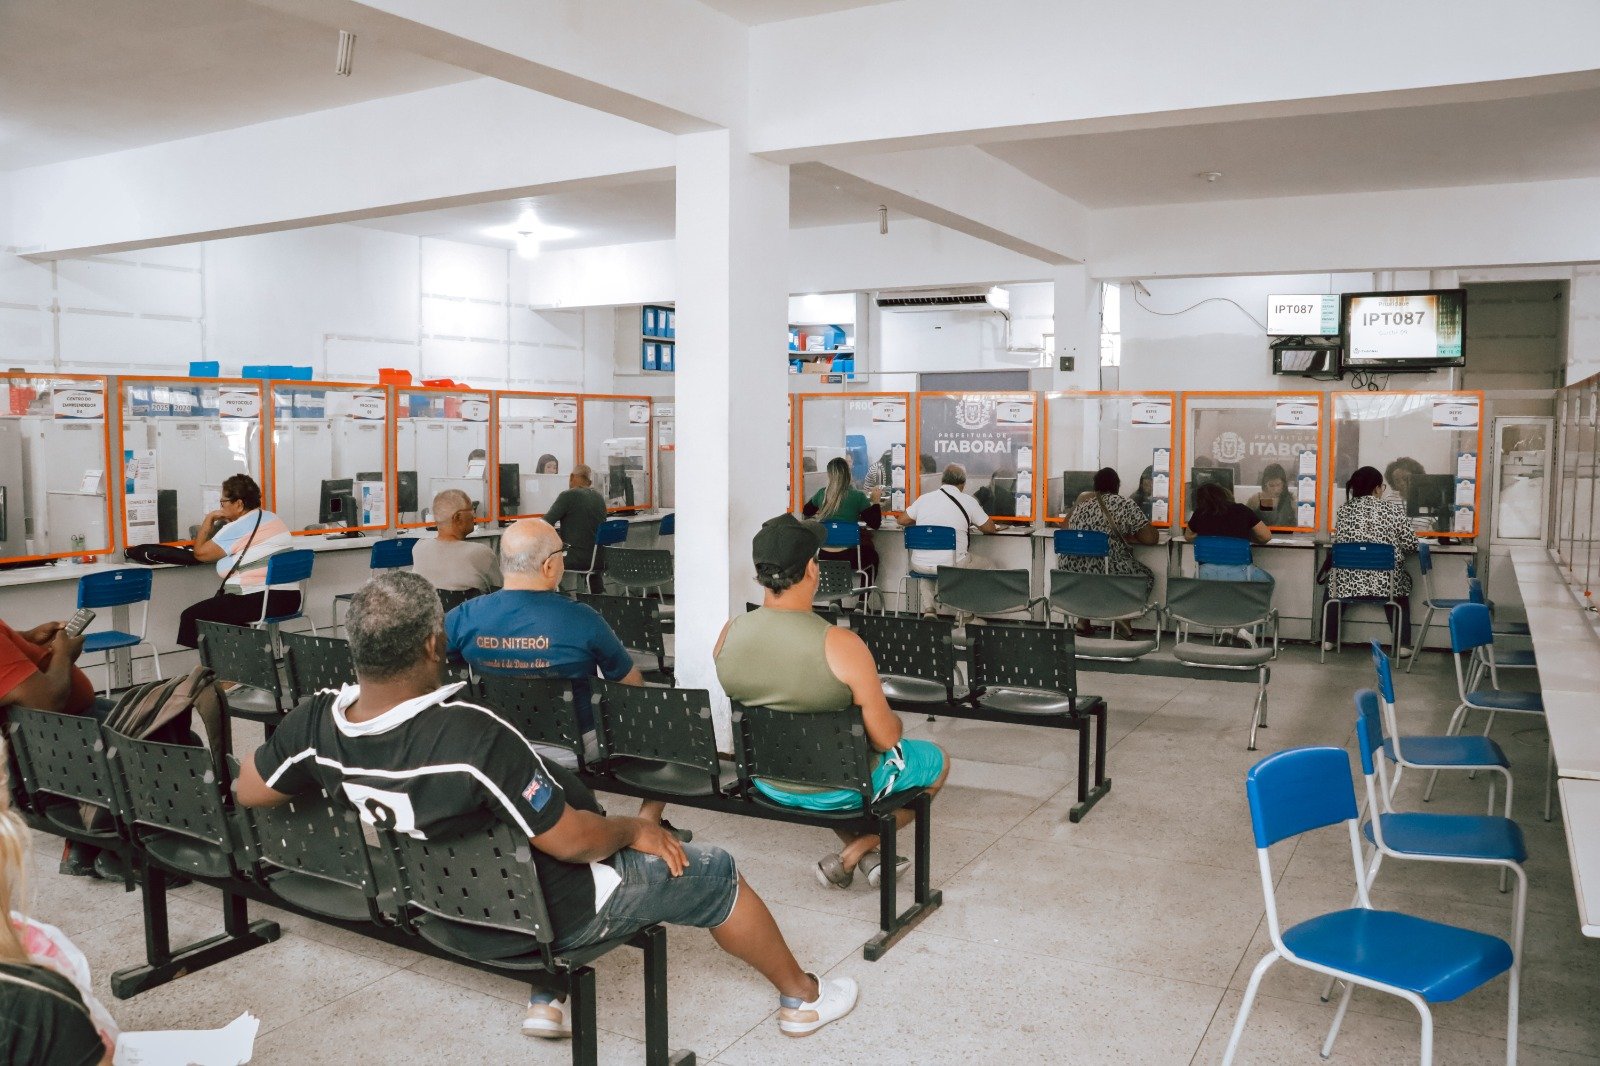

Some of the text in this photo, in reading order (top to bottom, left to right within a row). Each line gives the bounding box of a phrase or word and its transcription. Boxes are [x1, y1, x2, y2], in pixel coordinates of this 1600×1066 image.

[1275, 304, 1314, 314] IPT087
[1362, 311, 1426, 327] IPT087
[152, 404, 169, 412] 2025
[934, 438, 1012, 454] ITABORAÍ
[502, 635, 549, 649] NITERÓI
